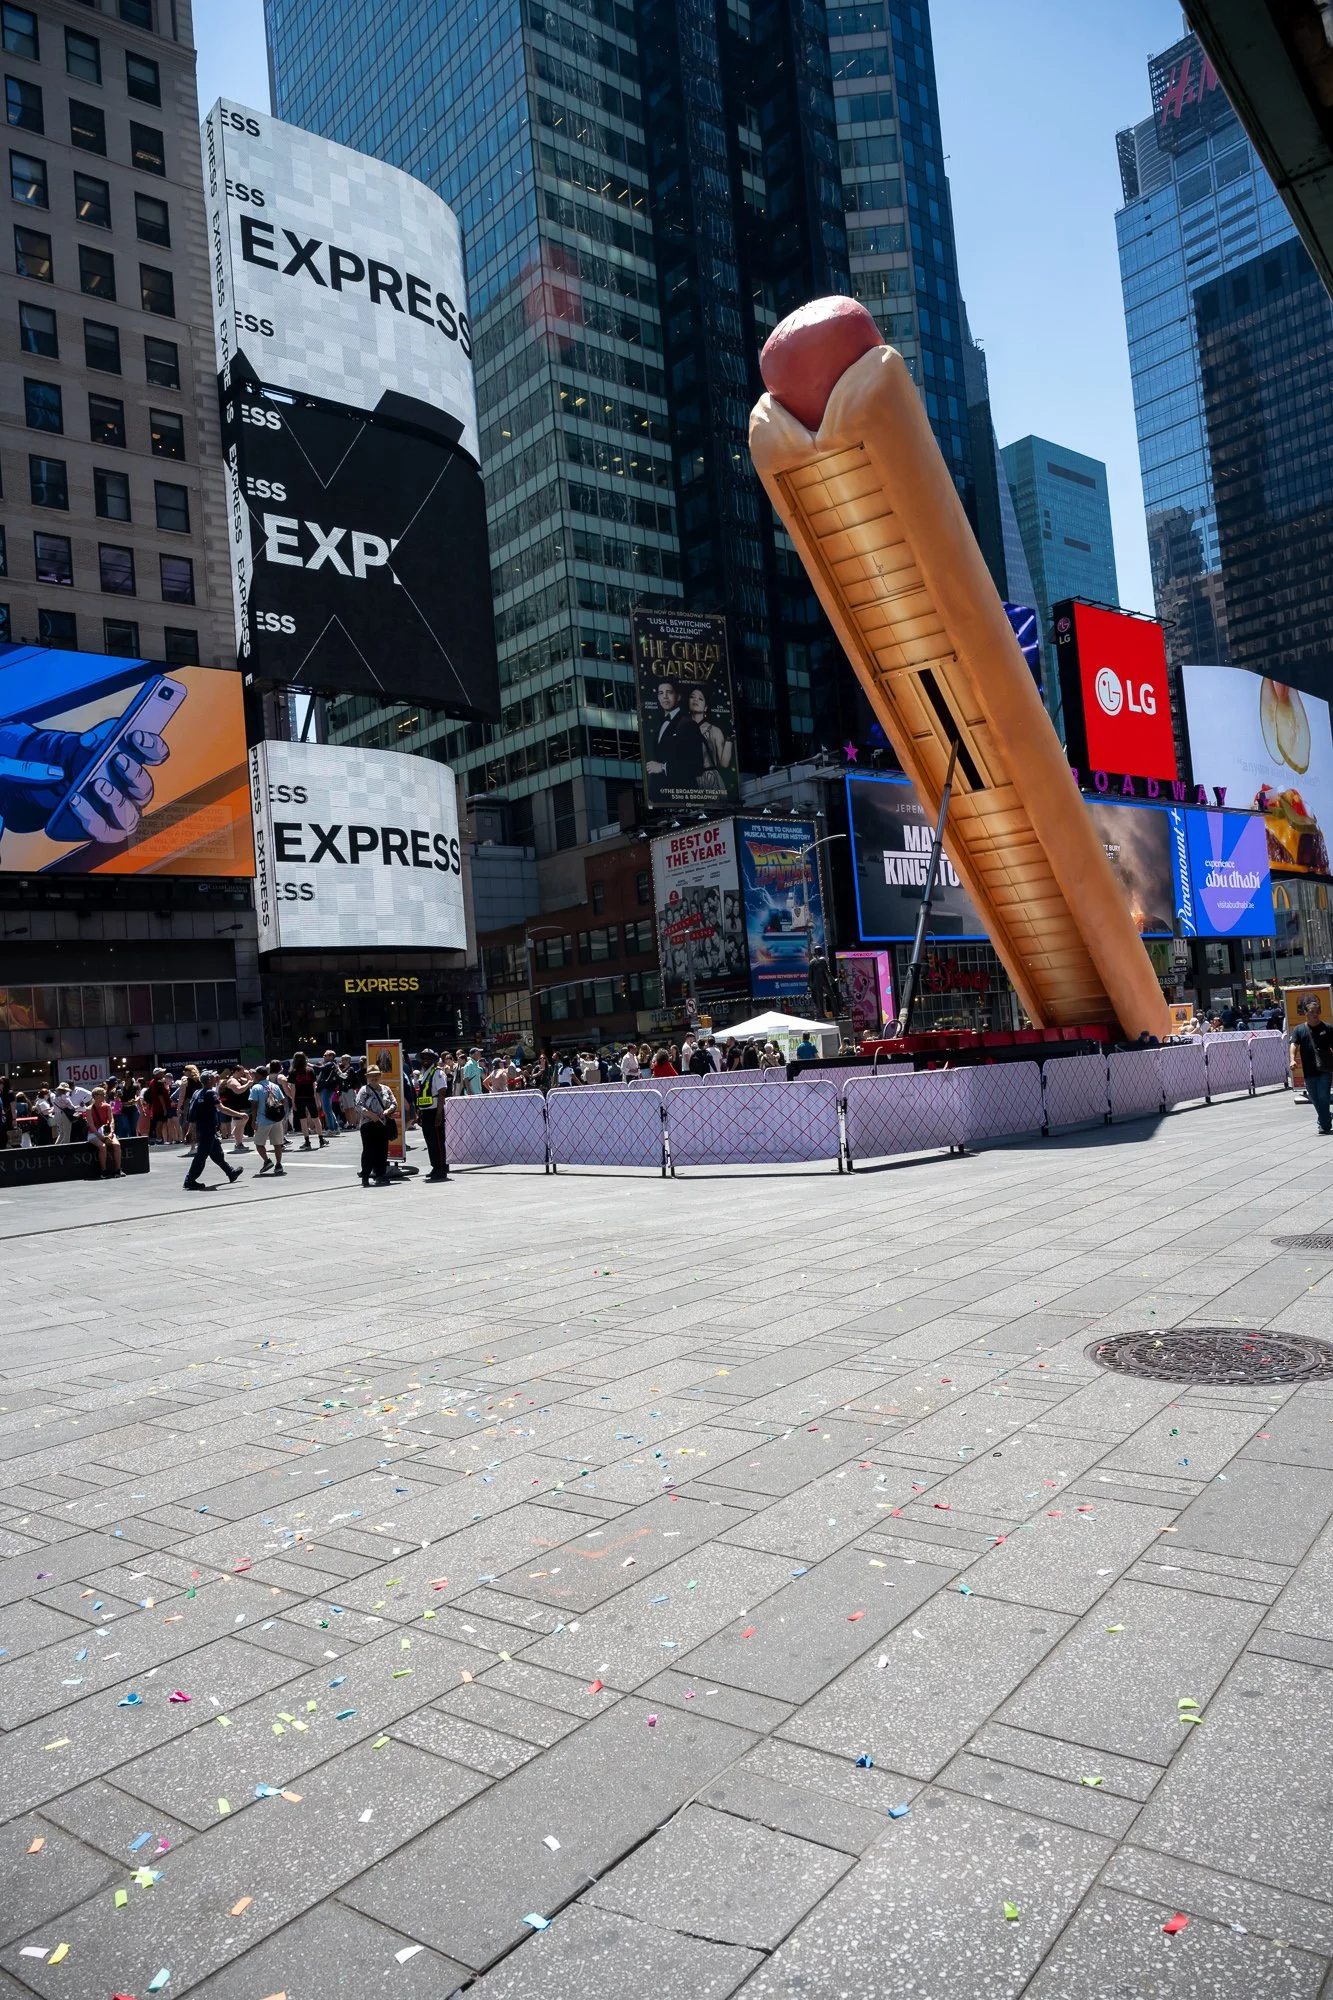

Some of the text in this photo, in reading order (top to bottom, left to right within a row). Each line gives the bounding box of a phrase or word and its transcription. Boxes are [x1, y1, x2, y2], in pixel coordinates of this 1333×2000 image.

[213, 210, 225, 308] EXPRESS
[239, 214, 472, 361] EXPRESS
[262, 512, 403, 585] EXP
[669, 619, 711, 629] BEWITCHING
[671, 640, 719, 662] GREAT
[1059, 633, 1071, 645] LG
[651, 658, 714, 681] GATSBY
[1126, 679, 1157, 715] LG
[273, 821, 461, 876] EXPRESS
[671, 827, 720, 853] BEST OF
[666, 841, 727, 868] THE YEAR!
[1205, 859, 1235, 868] experience
[256, 829, 270, 928] EXPRESS
[1206, 869, 1261, 888] abu dhabi
[344, 977, 420, 993] EXPRESS
[66, 1064, 98, 1081] 1560
